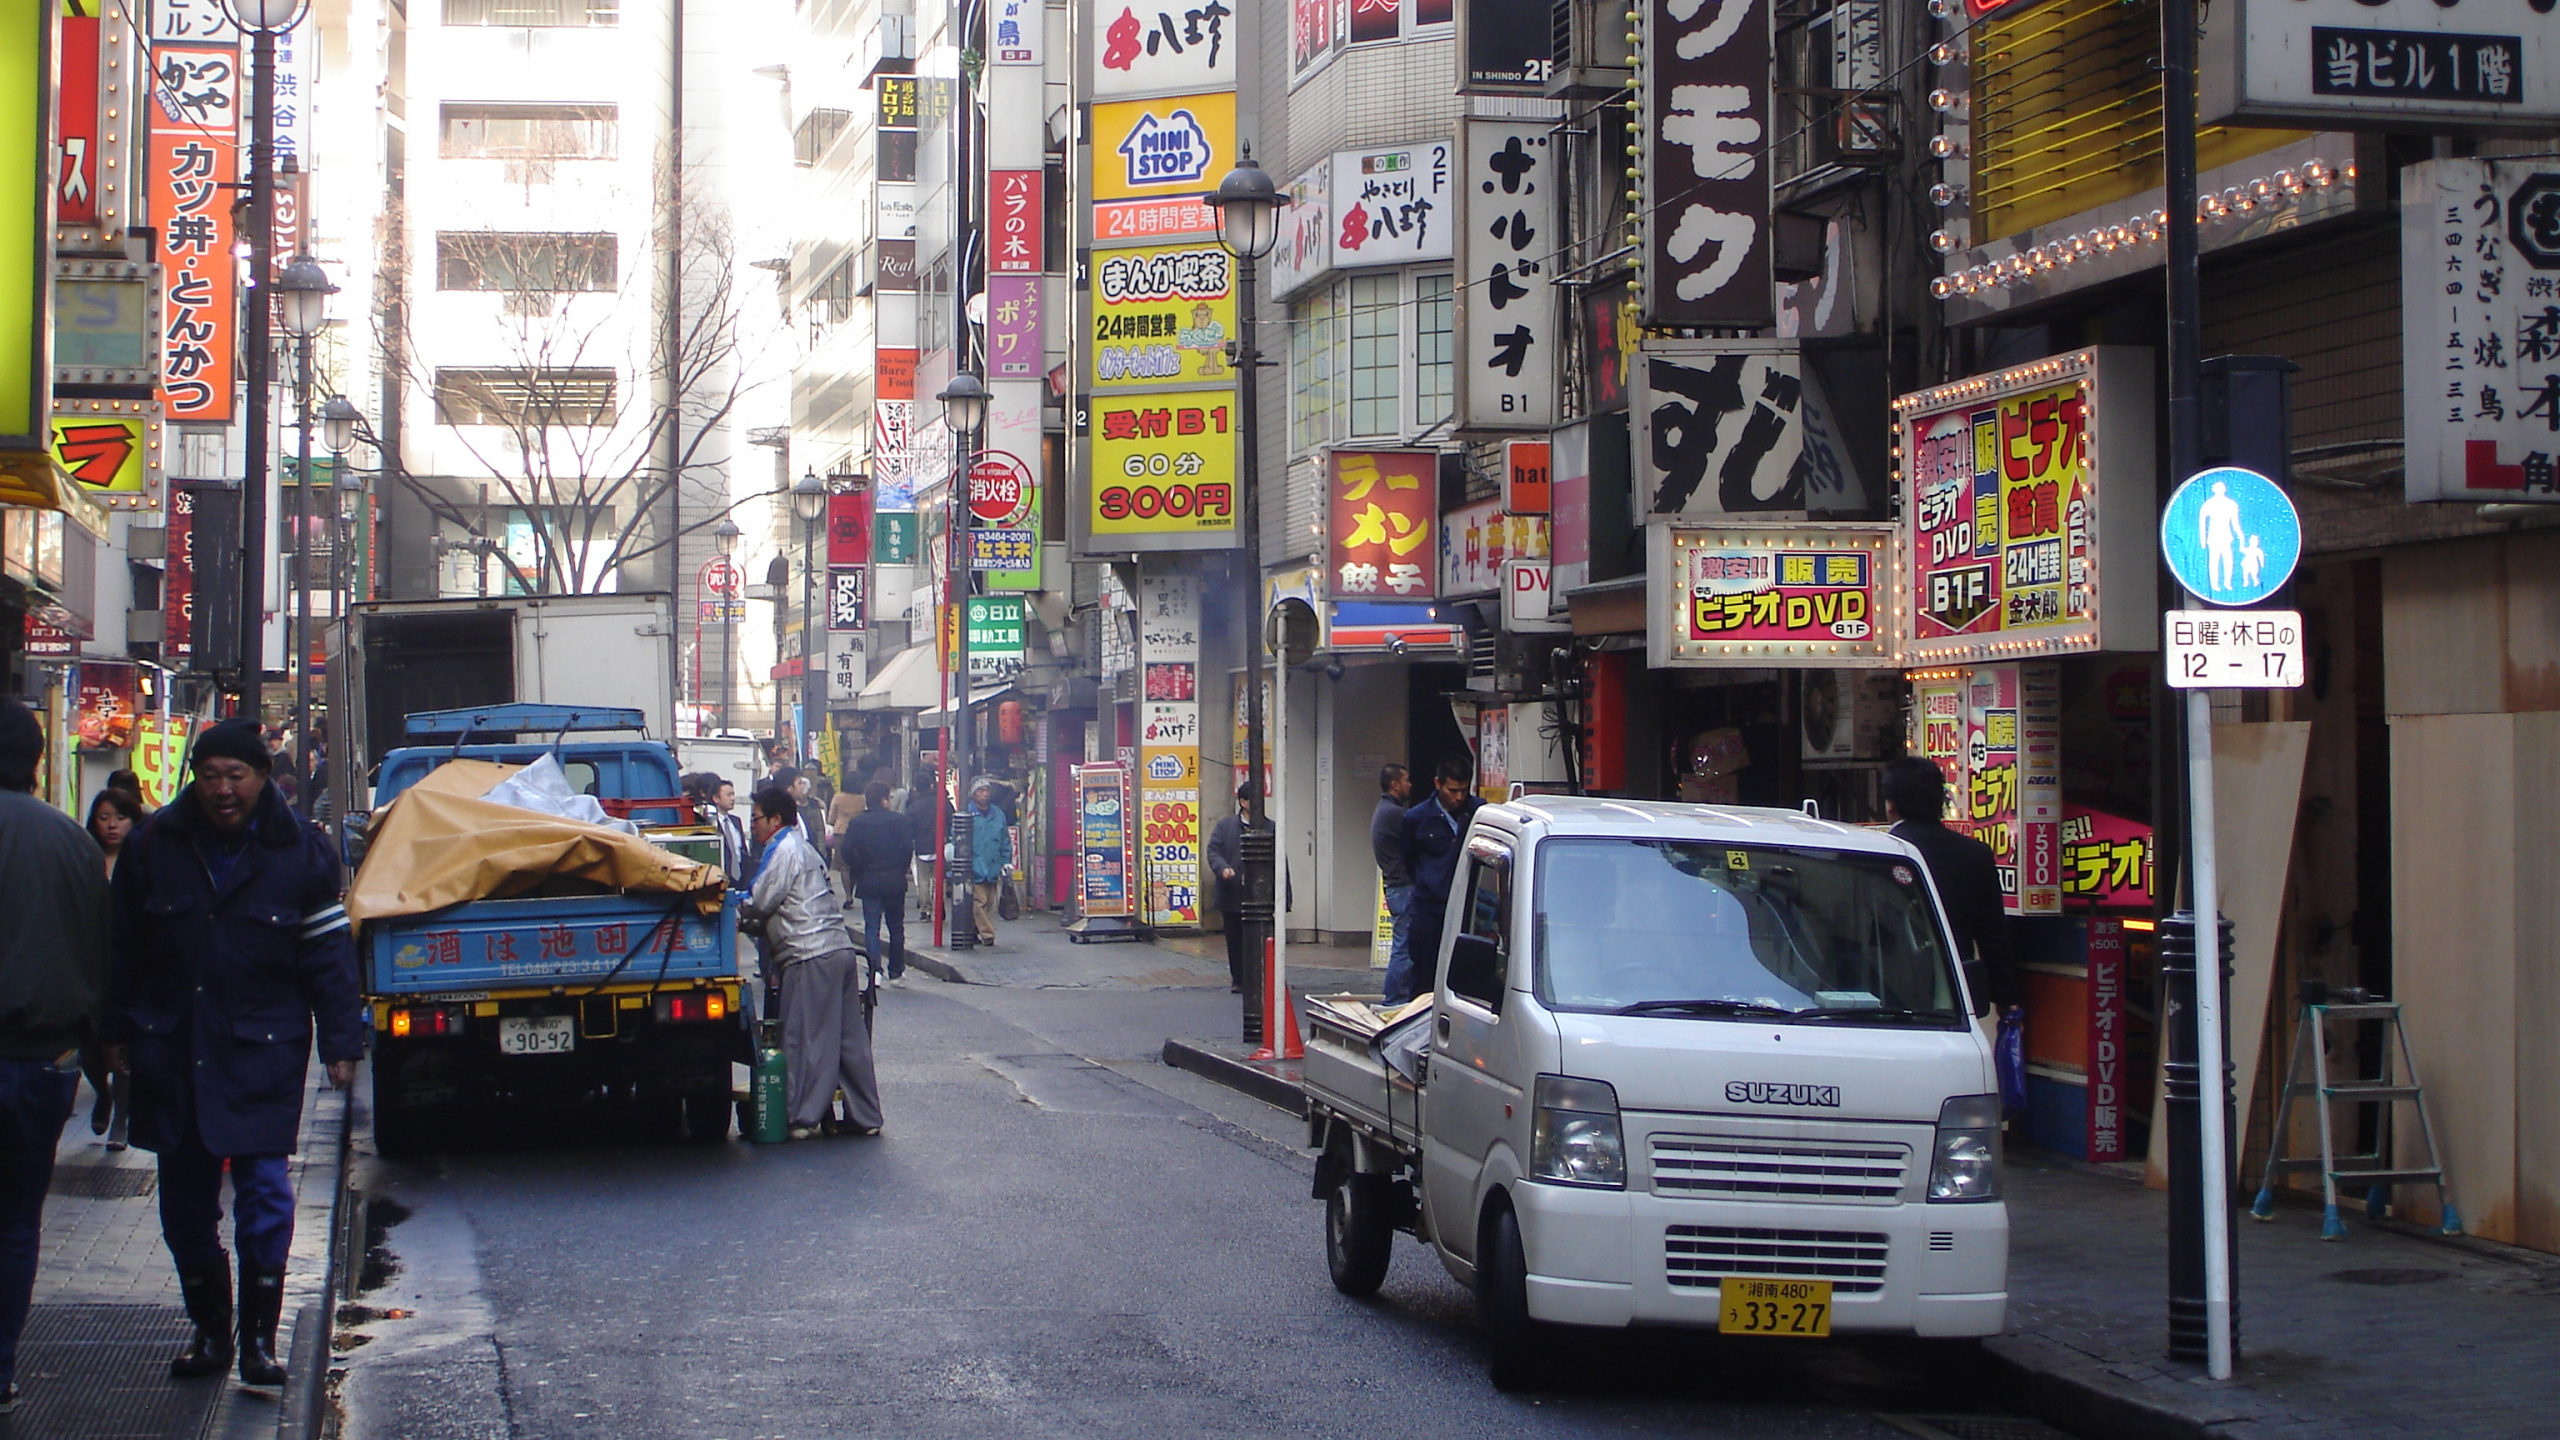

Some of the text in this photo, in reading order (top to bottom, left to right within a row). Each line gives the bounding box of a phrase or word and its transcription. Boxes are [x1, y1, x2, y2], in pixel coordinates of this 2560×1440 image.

[1473, 71, 1483, 80] IN
[1486, 71, 1521, 81] SHINDO
[2328, 38, 2512, 95] 当ビル1階
[1141, 130, 1190, 153] MINI
[1139, 152, 1193, 175] STOP
[1432, 146, 1446, 194] 2F
[1003, 174, 1030, 257] バラの木
[1109, 206, 1216, 236] 24時間営業
[165, 140, 217, 410] カツ丼・とんかつ
[879, 256, 914, 277] Real
[1104, 254, 1228, 297] まんが喫茶
[1025, 281, 1037, 333] スナック
[2474, 184, 2508, 422] うなぎ・焼鳥
[997, 300, 1020, 356] ポワ
[1097, 313, 1177, 340] 24時間営業
[1501, 394, 1527, 412] B1
[2002, 390, 2086, 482] ビデオ
[1124, 453, 1204, 477] 60分
[1339, 454, 1419, 500] ラー
[970, 479, 1017, 503] 消火栓
[1101, 483, 1231, 519] 300円
[1976, 421, 1997, 547] 販売
[1918, 488, 1959, 532] ビデオ
[1341, 502, 1428, 556] メン
[1932, 522, 1971, 565] DVD
[976, 541, 1031, 558] セキネ
[2008, 545, 2060, 584] 24H営業
[1339, 561, 1426, 594] 餃子
[1701, 556, 1768, 580] 激安!!
[1783, 557, 1860, 584] 販売
[1695, 590, 1781, 630] ビデオ
[1786, 590, 1865, 628] DVD
[1933, 574, 1984, 613] B1F
[990, 605, 1019, 620] 日立
[1835, 623, 1866, 634] B1F
[2175, 620, 2296, 646] 日曜・休日の
[837, 652, 853, 689] 有明
[2183, 652, 2208, 678] 12
[2262, 653, 2287, 678] 17
[1971, 763, 2016, 819] ビデオ
[2027, 776, 2056, 785] REAL
[2030, 894, 2055, 905] B1F
[426, 918, 688, 966] 酒は池田屋
[516, 1031, 570, 1050] 90-92
[2095, 962, 2117, 1152] ビデオ・DVD販売
[1726, 1081, 1840, 1107] SUZUKI
[1748, 1282, 1808, 1298] 湘南 480
[1730, 1301, 1826, 1332] う 33-27
